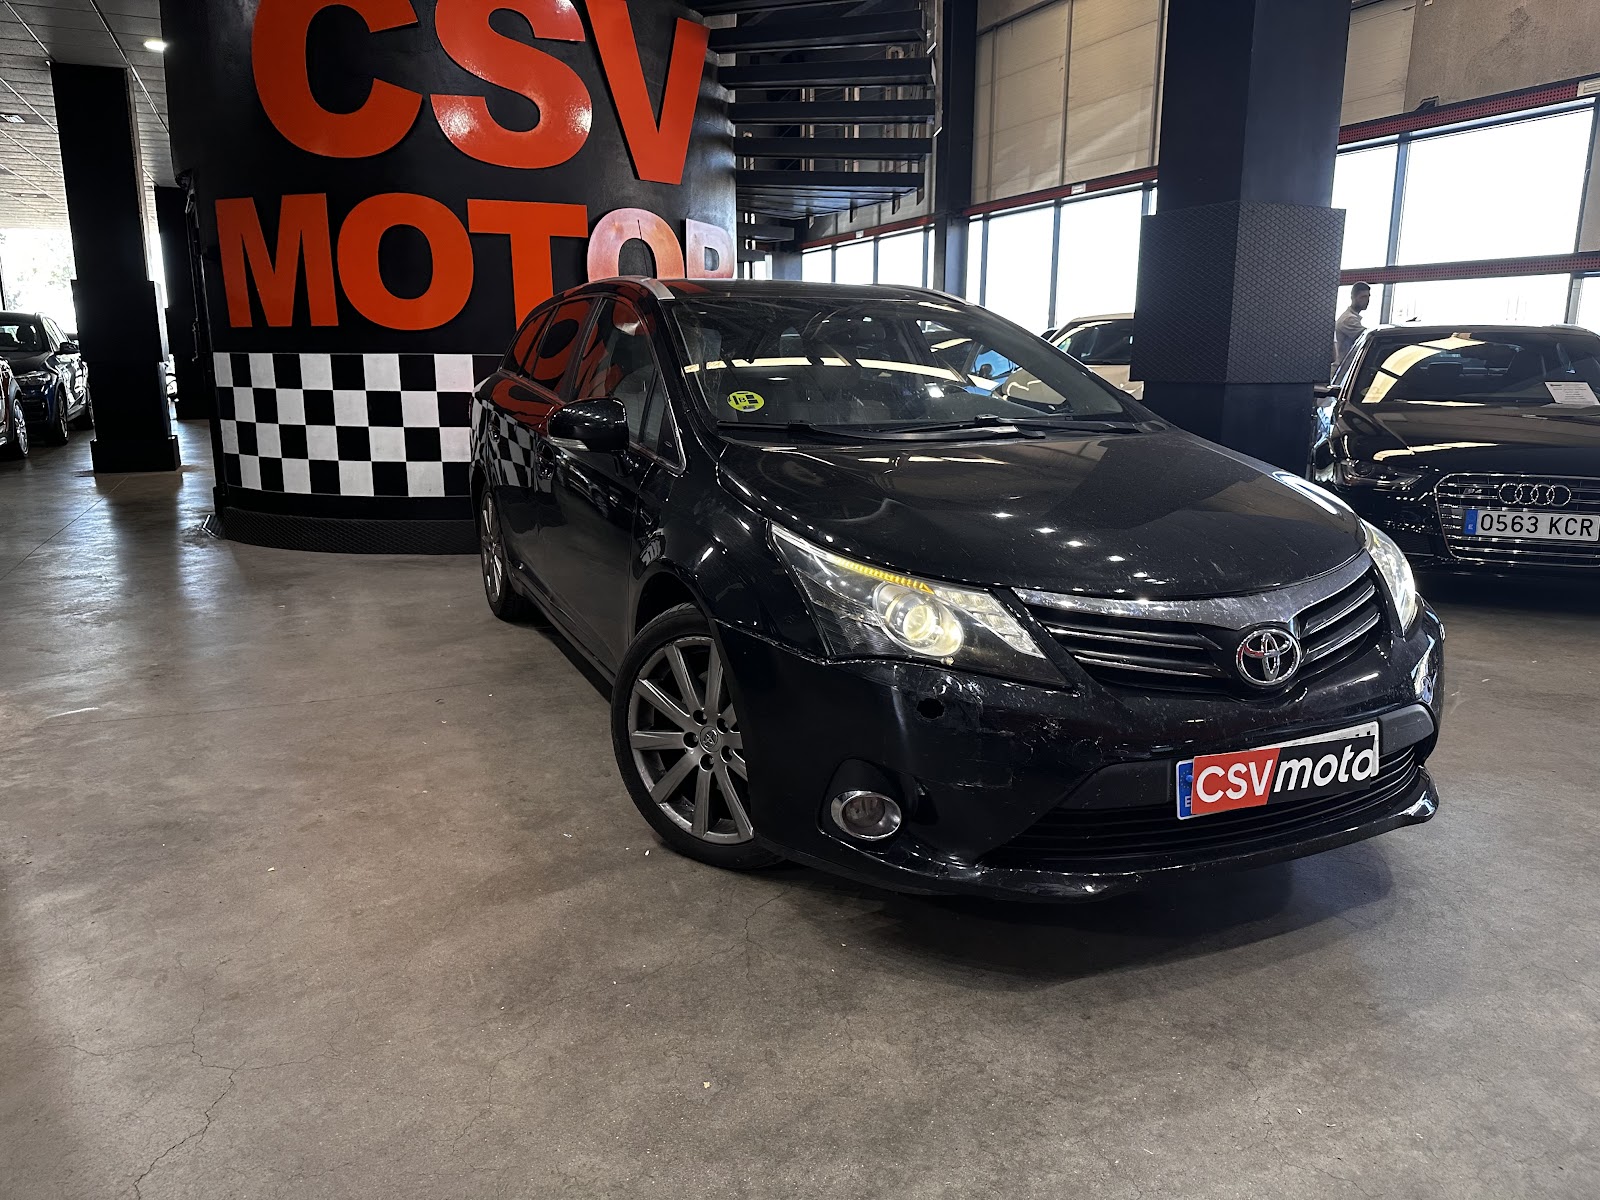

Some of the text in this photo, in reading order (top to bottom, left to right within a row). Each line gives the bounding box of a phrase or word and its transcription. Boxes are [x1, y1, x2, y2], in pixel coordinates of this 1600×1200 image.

[251, 0, 711, 185] CSV
[1480, 513, 1538, 533] 0563
[1548, 516, 1594, 536] KCR
